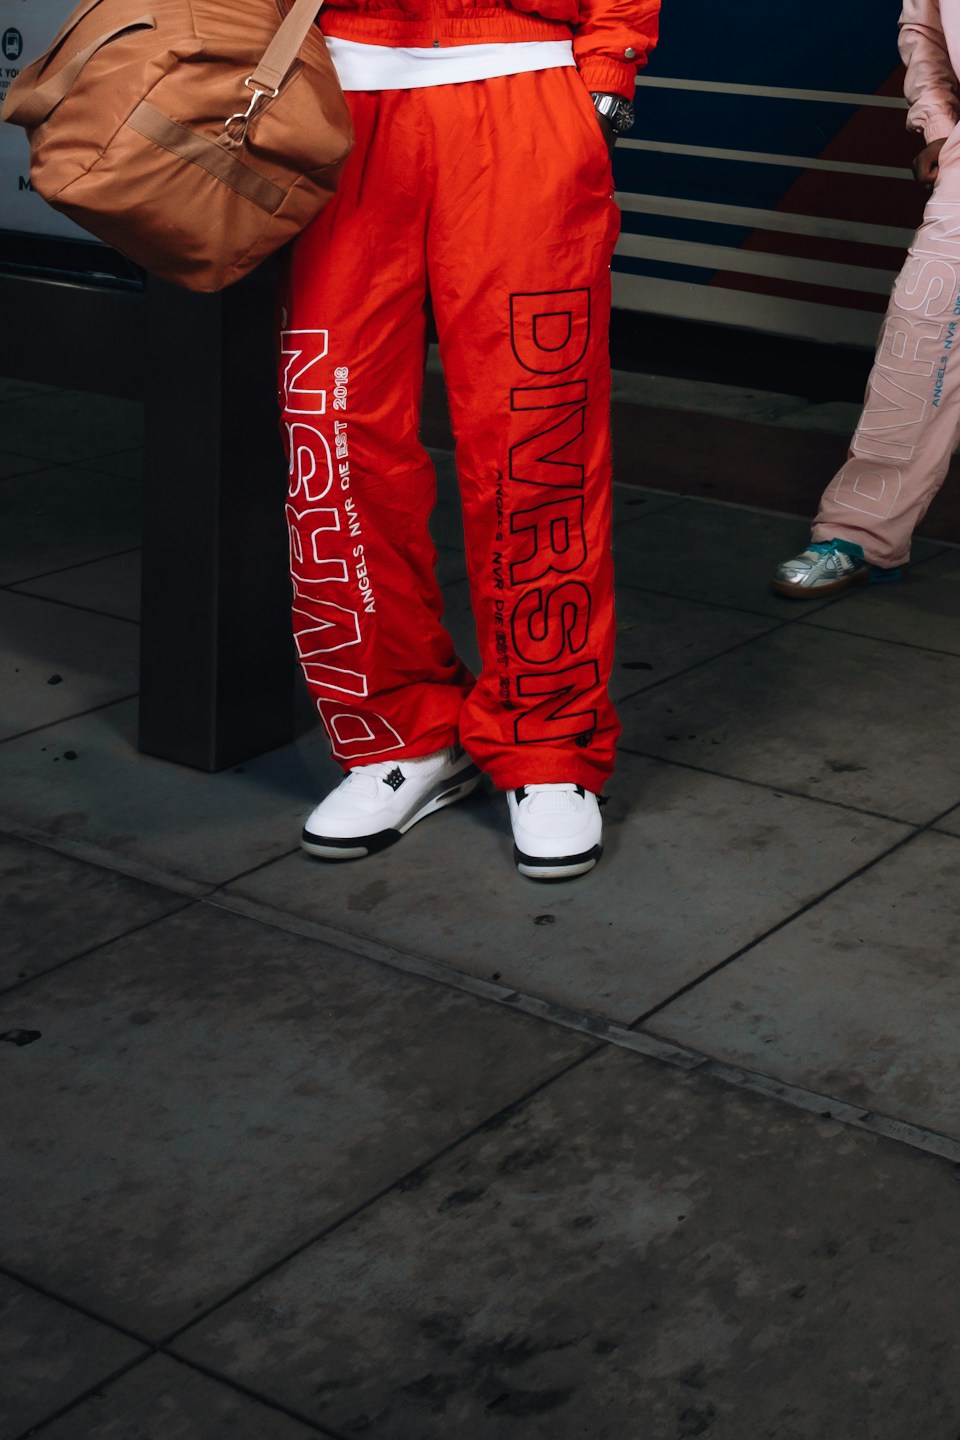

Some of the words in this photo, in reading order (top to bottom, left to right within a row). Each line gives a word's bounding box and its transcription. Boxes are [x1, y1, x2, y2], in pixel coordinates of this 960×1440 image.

[932, 355, 948, 408] ANGELS
[944, 321, 957, 349] NVR
[333, 366, 349, 411] 2018
[334, 420, 349, 459] EST
[338, 461, 350, 491] DIE
[344, 496, 362, 537] NVR
[508, 287, 600, 745] DIVRSN
[352, 544, 376, 613] ANGELS
